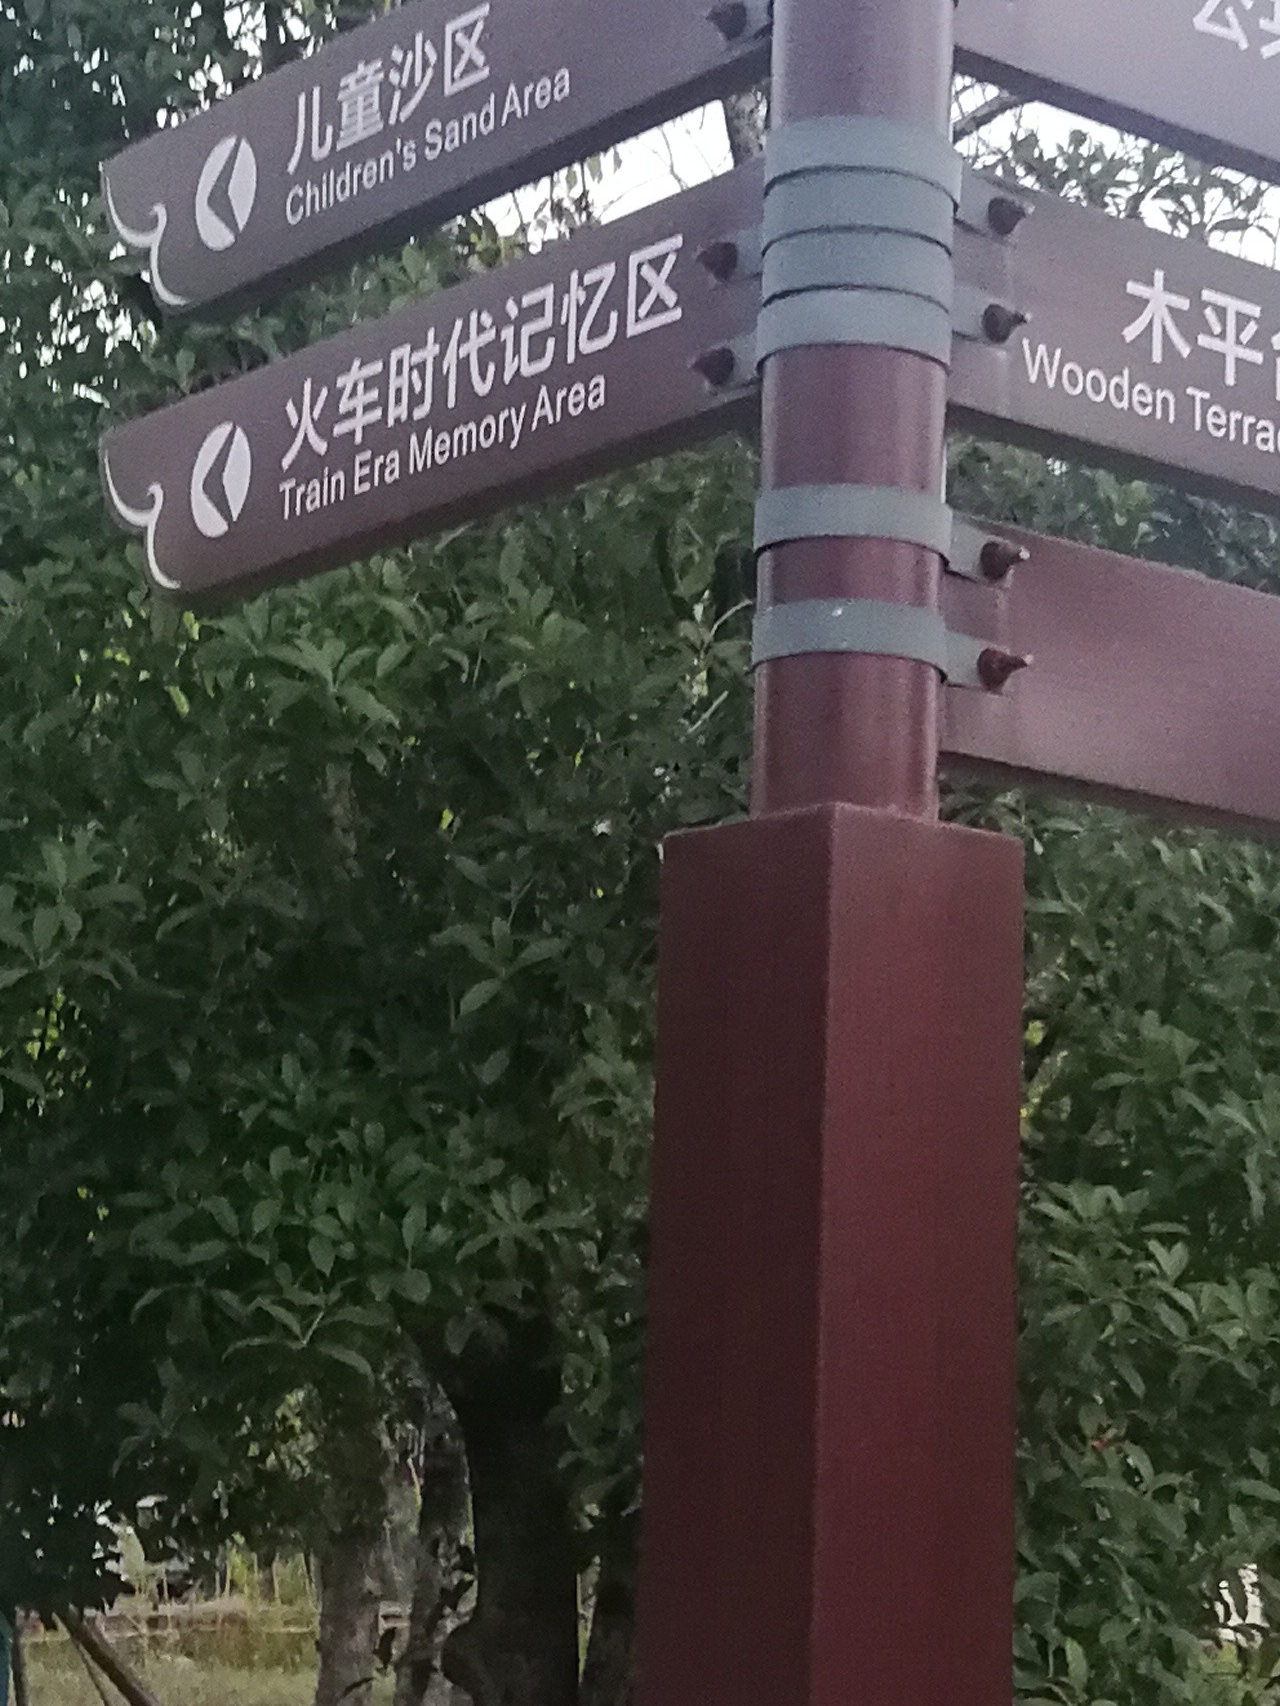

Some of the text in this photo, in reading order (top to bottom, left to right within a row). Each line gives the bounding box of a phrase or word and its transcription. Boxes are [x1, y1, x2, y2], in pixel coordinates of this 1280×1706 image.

[284, 66, 571, 226] Children's Sand Area
[286, 2, 491, 175] 儿童沙区
[281, 234, 684, 472] 火车时代记忆区
[1021, 336, 1176, 423] Wooden
[279, 373, 607, 521] Train Era Memory Area
